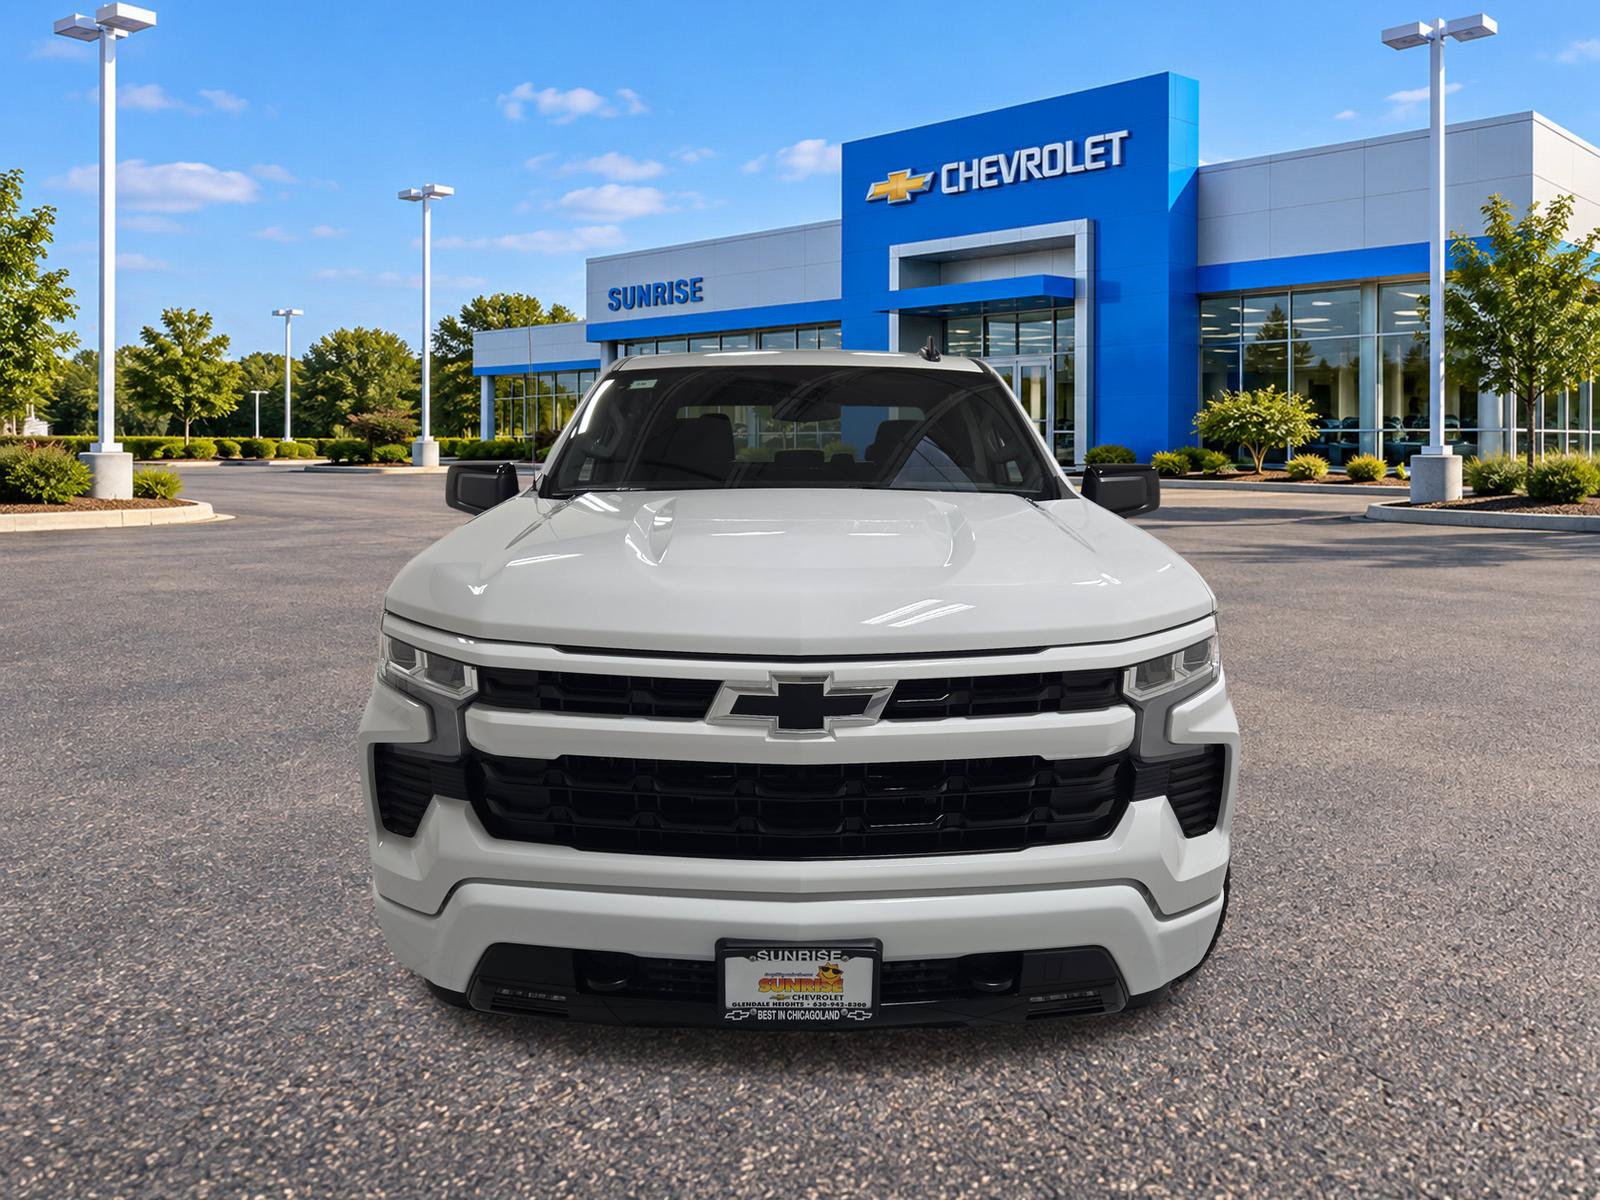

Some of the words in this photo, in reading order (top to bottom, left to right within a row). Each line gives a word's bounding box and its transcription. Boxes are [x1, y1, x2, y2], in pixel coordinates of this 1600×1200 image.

[941, 130, 1129, 195] CHEVROLET
[608, 277, 704, 312] SUNRISE
[756, 950, 842, 962] SUNRISE
[758, 977, 844, 993] SUNRISE
[757, 1010, 777, 1021] BEST
[778, 1010, 786, 1021] IN
[787, 1009, 840, 1021] CHICAGOLAND
